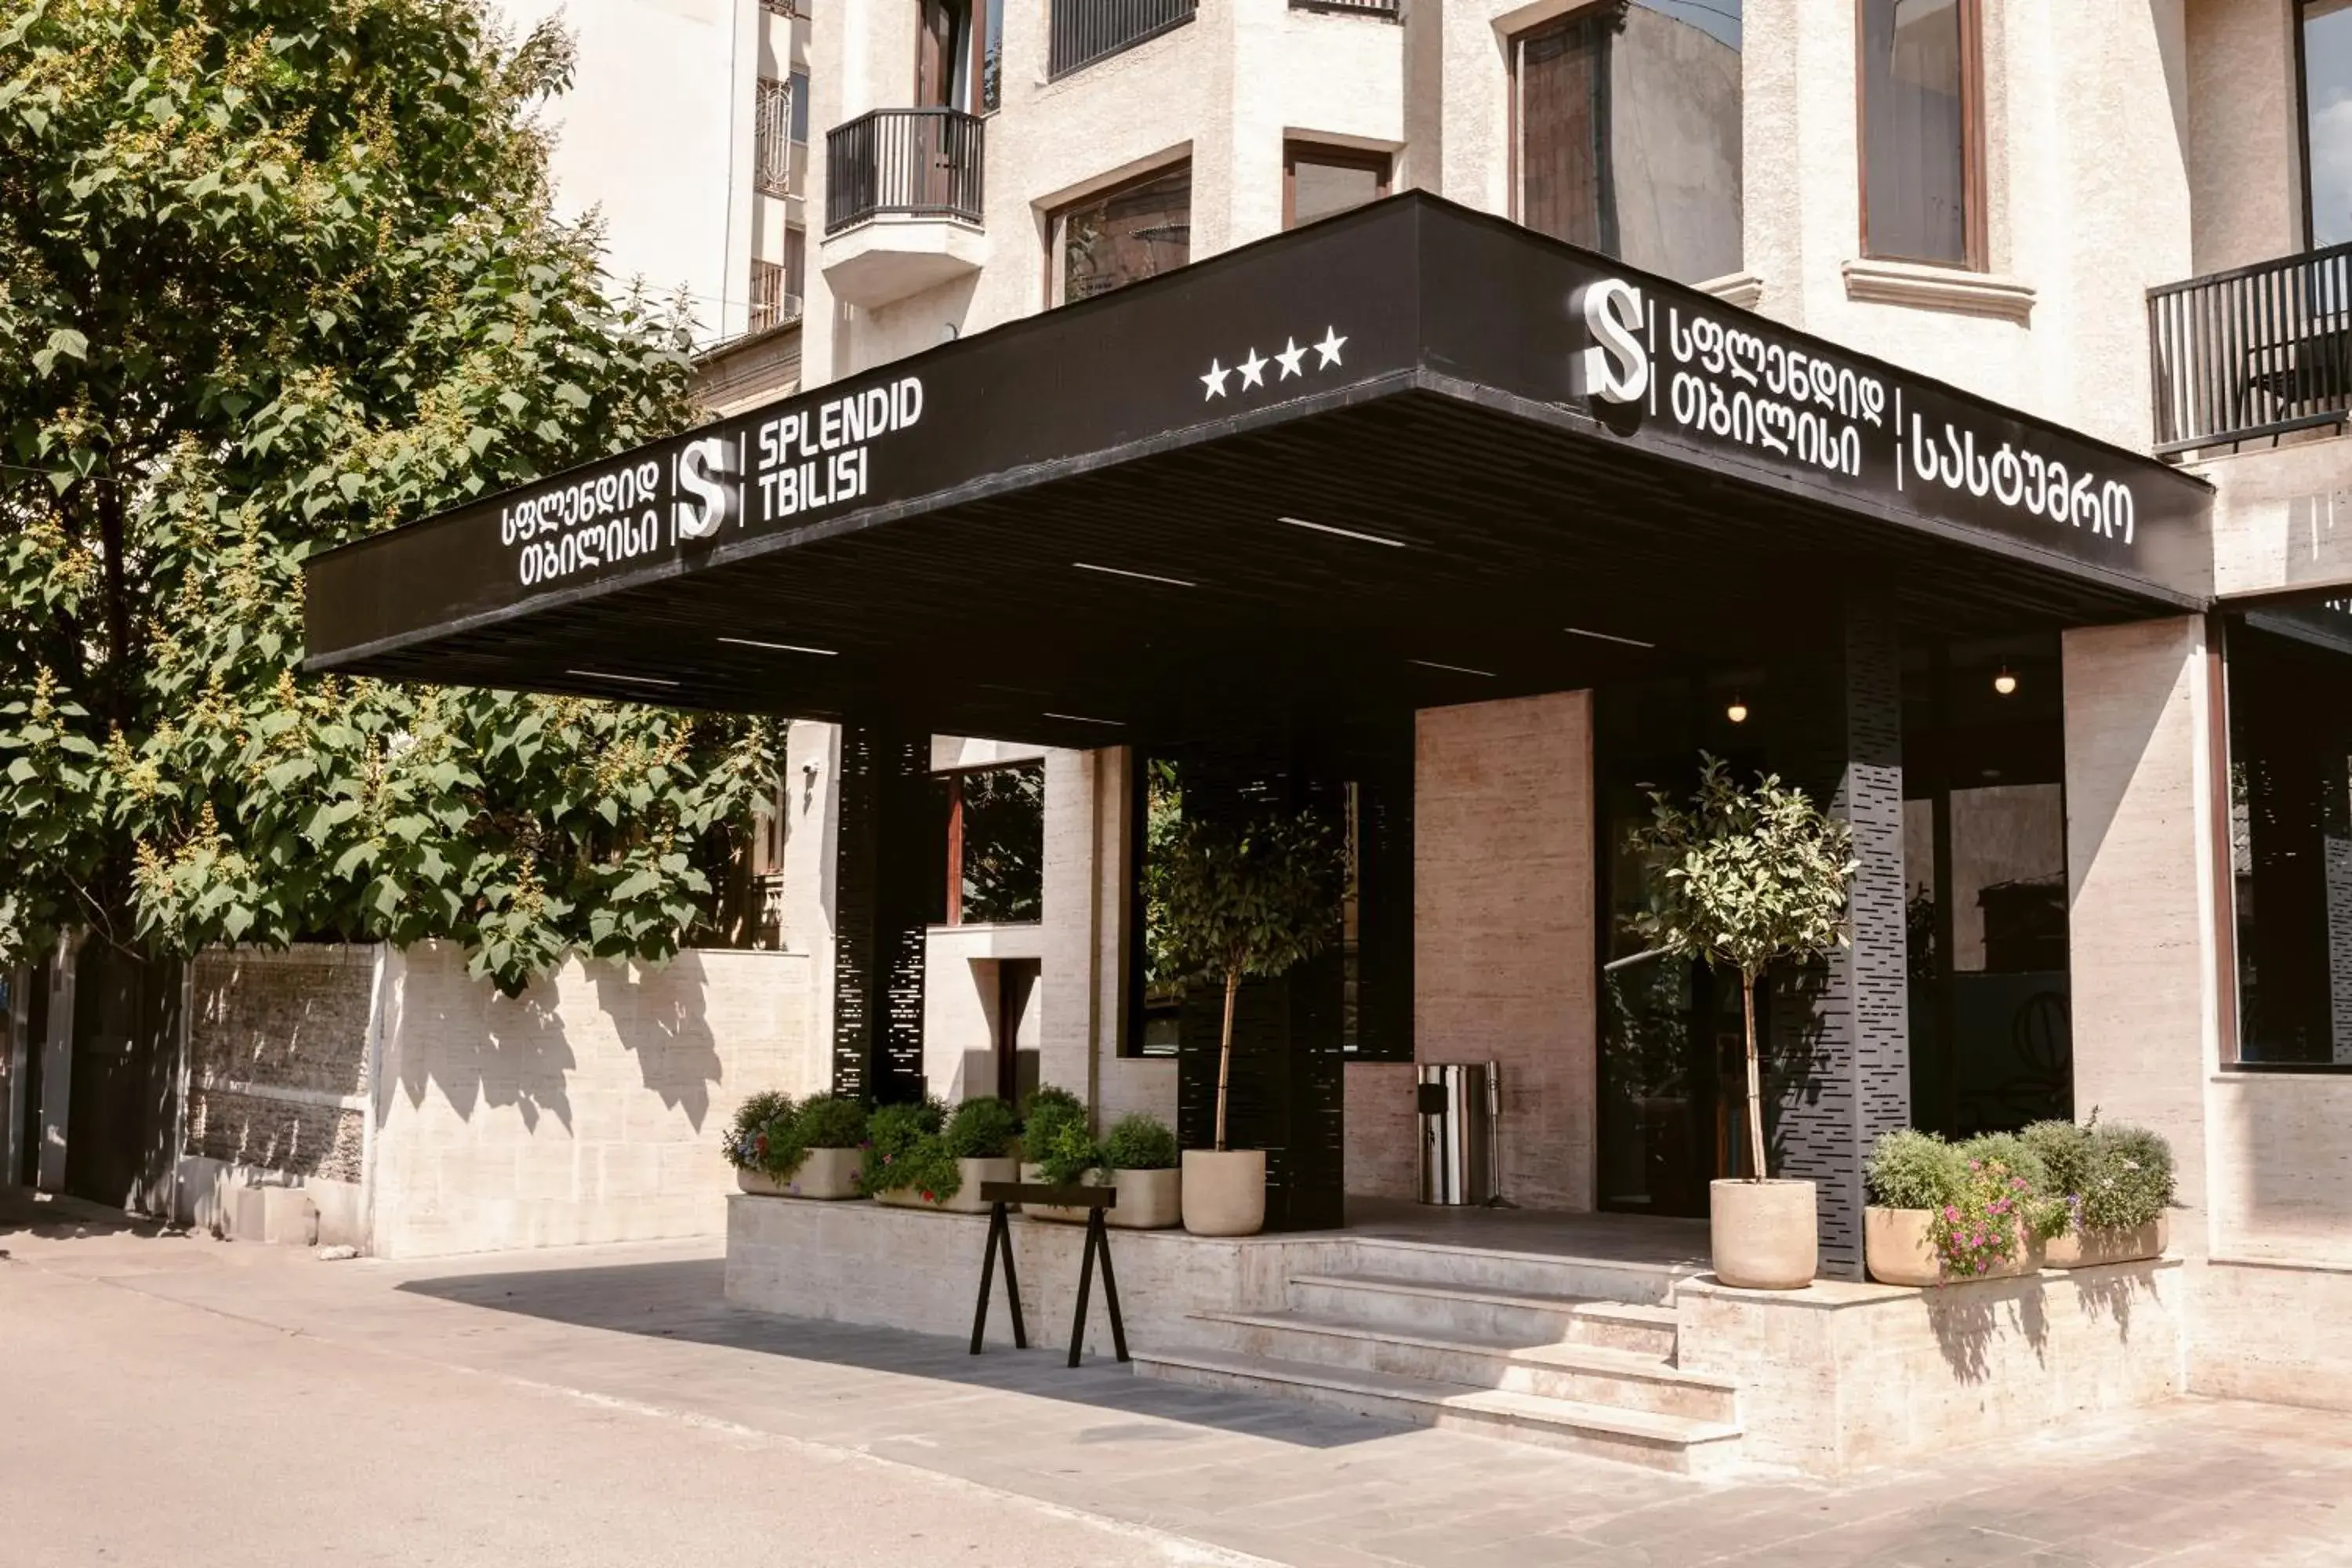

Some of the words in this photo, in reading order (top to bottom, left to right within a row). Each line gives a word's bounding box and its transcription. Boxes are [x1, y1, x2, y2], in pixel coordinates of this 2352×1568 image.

[1582, 278, 1650, 404] S
[1669, 307, 1885, 428] სფლენდიდ
[757, 376, 924, 470] SPLENDID
[1671, 371, 1860, 477] თბილისი
[501, 461, 659, 546] სფლენდიდ
[678, 437, 726, 539] S
[757, 447, 869, 521] TBILISI
[1912, 412, 2134, 545] სასტუმრო
[520, 510, 659, 586] თბილისი
